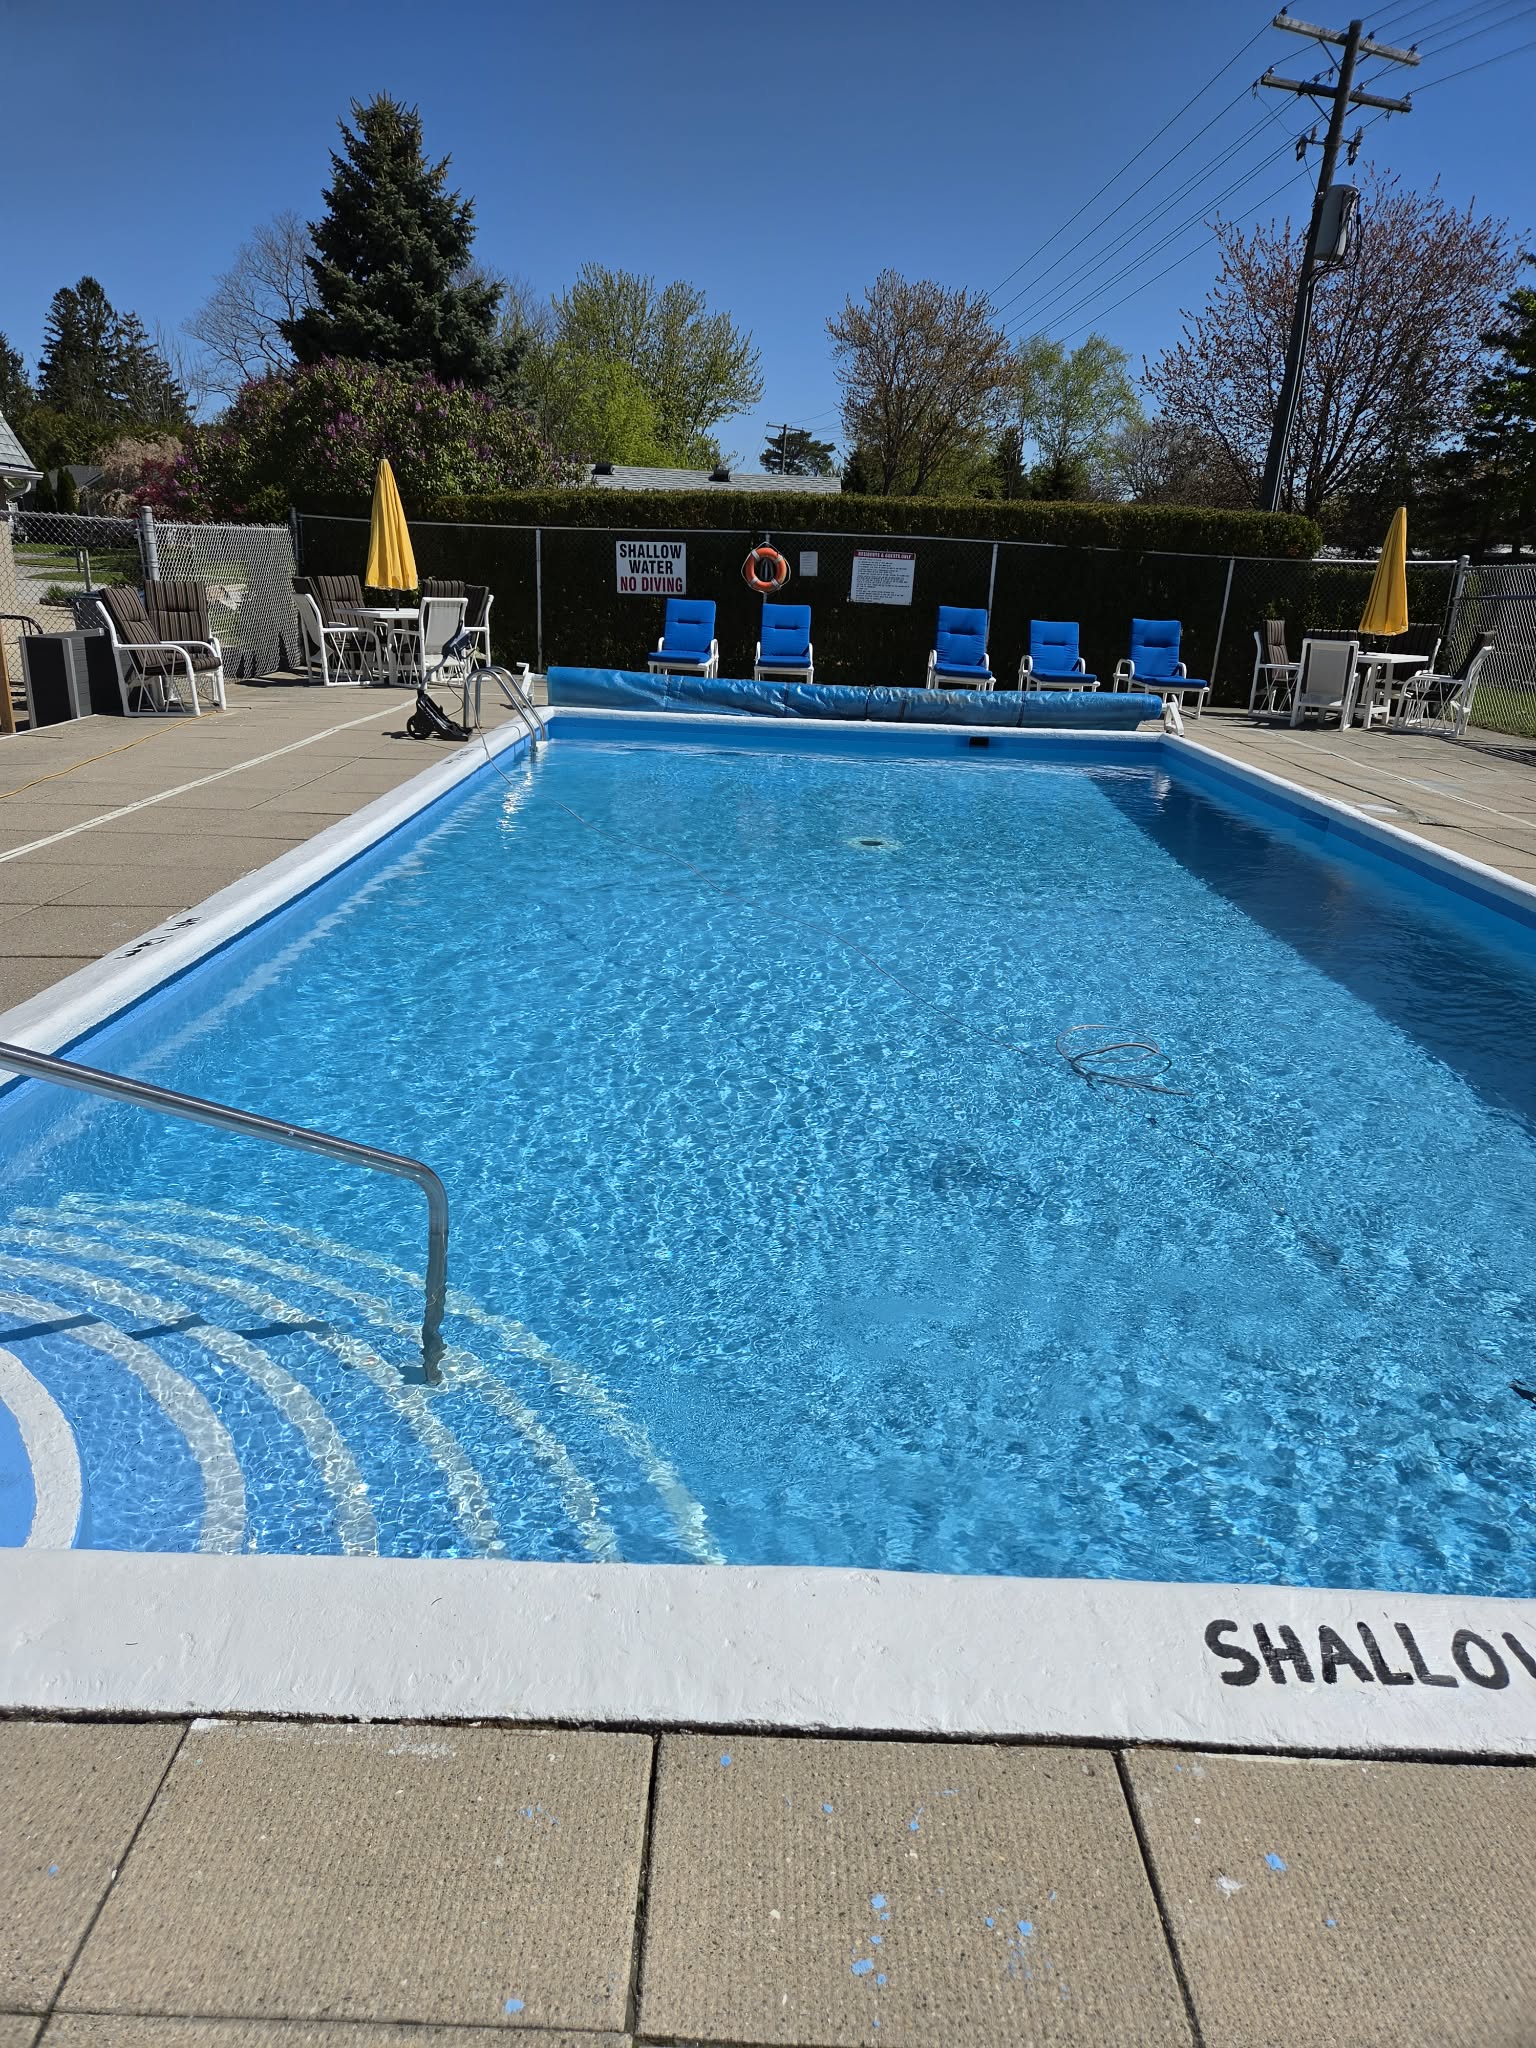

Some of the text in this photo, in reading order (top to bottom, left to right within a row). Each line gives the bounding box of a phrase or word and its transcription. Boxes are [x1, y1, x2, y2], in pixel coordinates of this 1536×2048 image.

[619, 543, 682, 559] SHALLOW
[628, 560, 673, 575] WATER
[620, 575, 683, 593] NO DIVING
